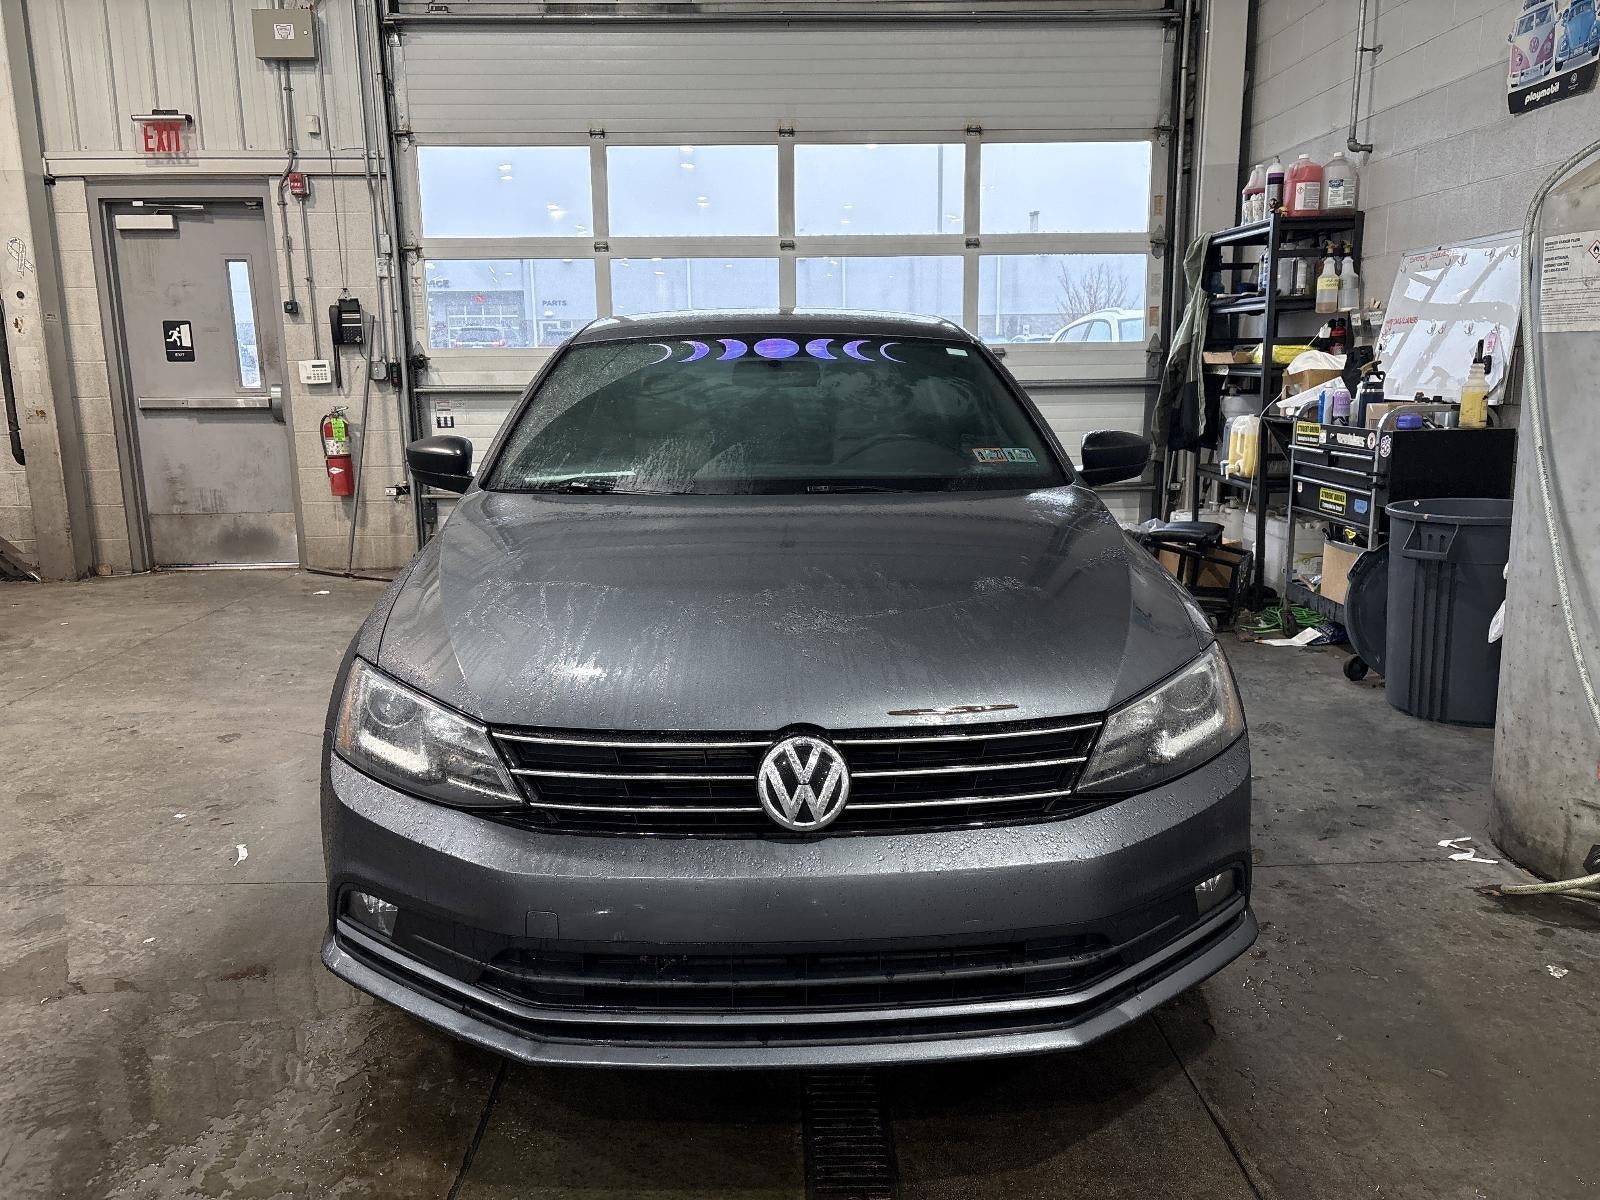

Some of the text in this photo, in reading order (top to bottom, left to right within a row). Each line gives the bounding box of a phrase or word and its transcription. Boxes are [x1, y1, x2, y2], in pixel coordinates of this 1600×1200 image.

[1524, 82, 1560, 105] playmobil
[143, 122, 181, 152] EXIT
[542, 299, 567, 307] PARTS
[759, 737, 849, 830] VW
